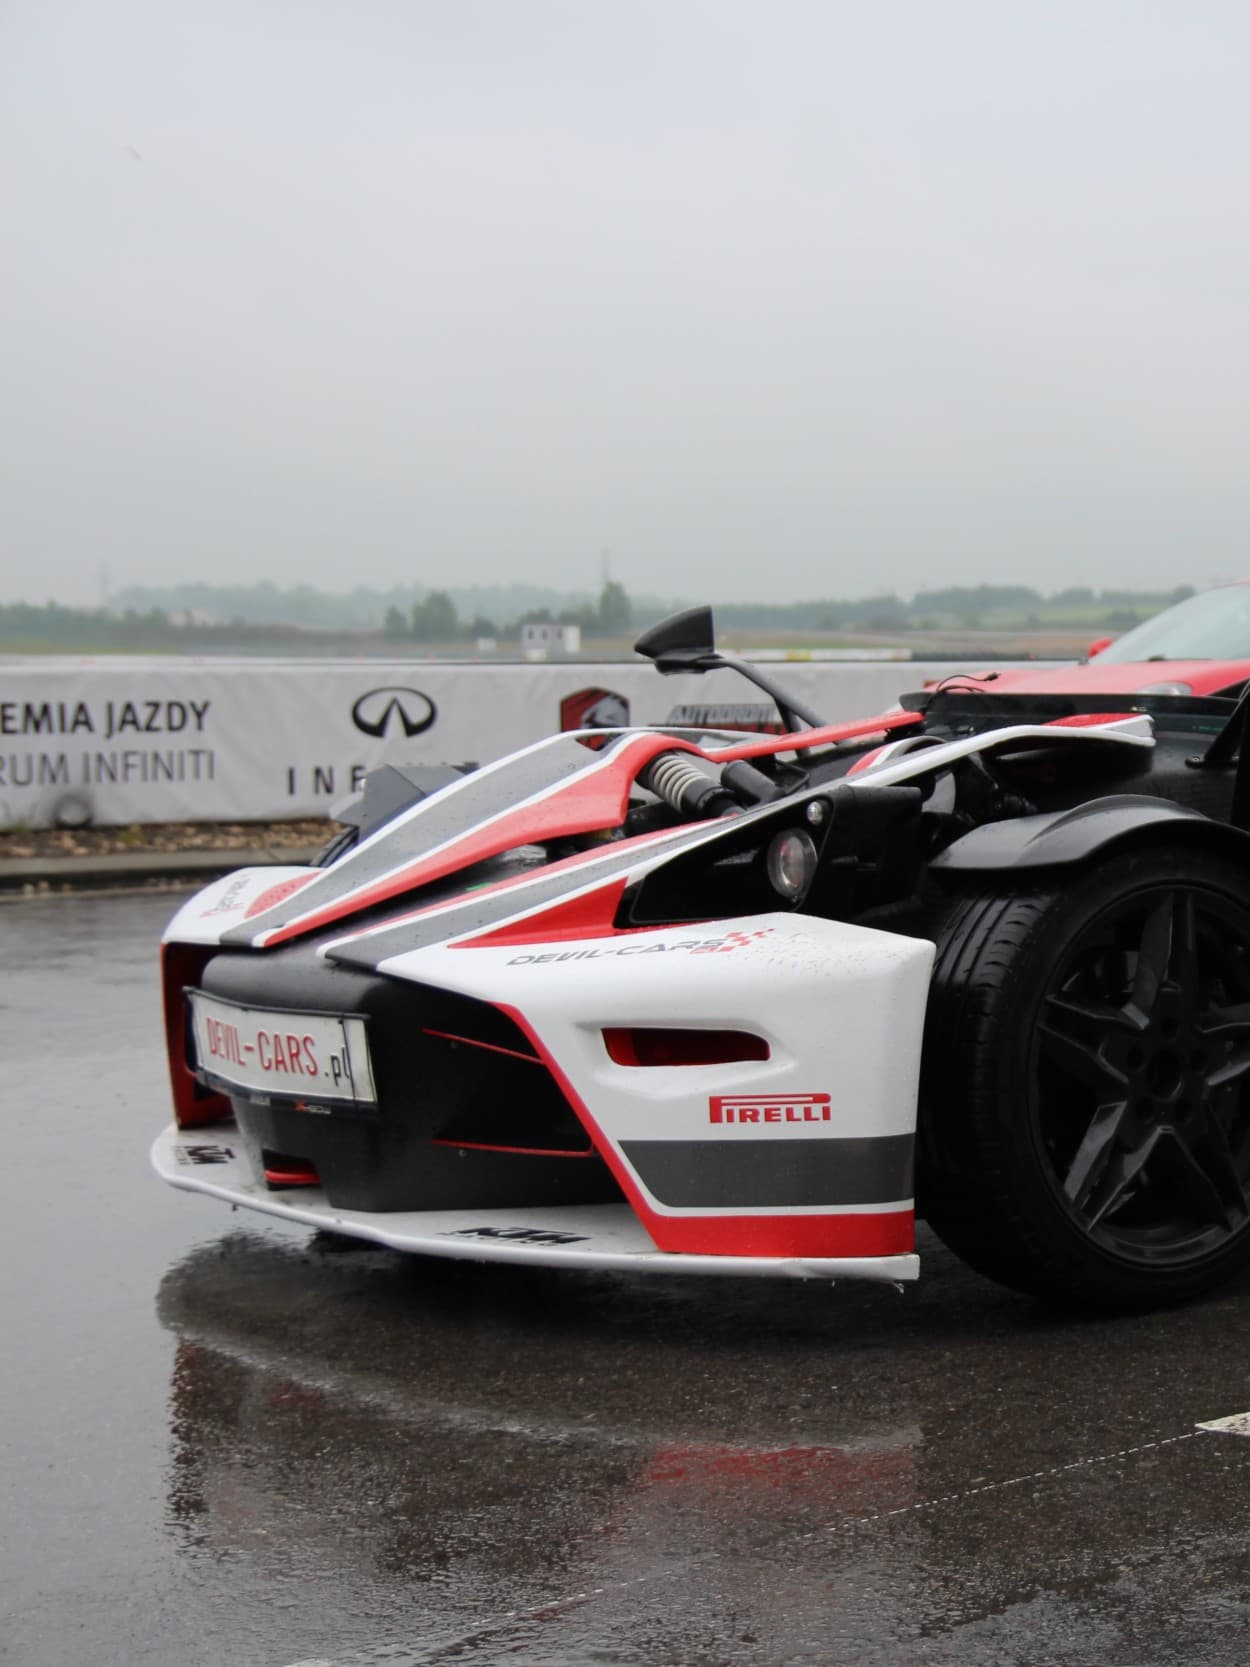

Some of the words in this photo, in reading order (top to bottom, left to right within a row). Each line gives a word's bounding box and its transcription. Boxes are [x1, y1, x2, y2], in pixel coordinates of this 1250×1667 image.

[105, 700, 210, 740] JAZDY
[83, 748, 214, 784] INFINITI
[506, 938, 727, 967] DEVIL-CARS
[709, 1092, 832, 1123] PIRELLI
